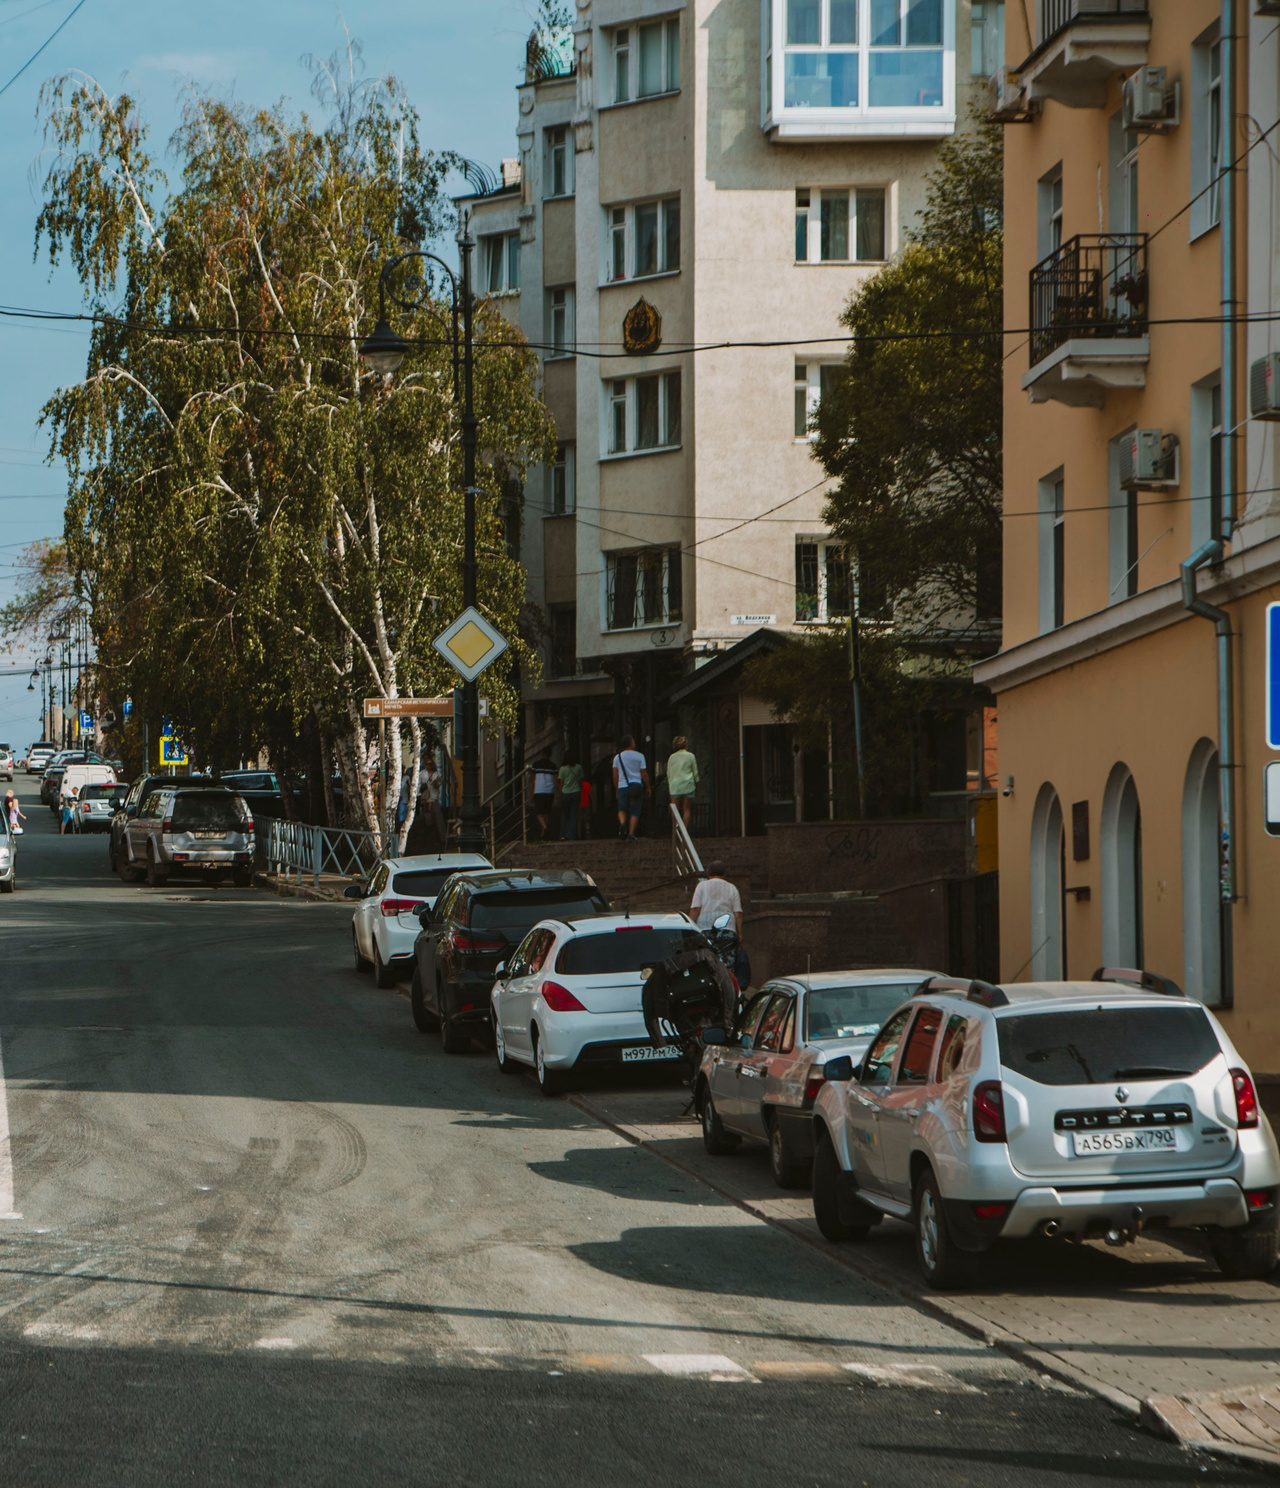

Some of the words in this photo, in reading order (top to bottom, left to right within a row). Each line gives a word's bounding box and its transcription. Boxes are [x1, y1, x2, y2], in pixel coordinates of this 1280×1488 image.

[660, 631, 666, 643] 3
[1062, 1111, 1188, 1127] DUSTER
[1082, 1135, 1147, 1152] А565ВХ
